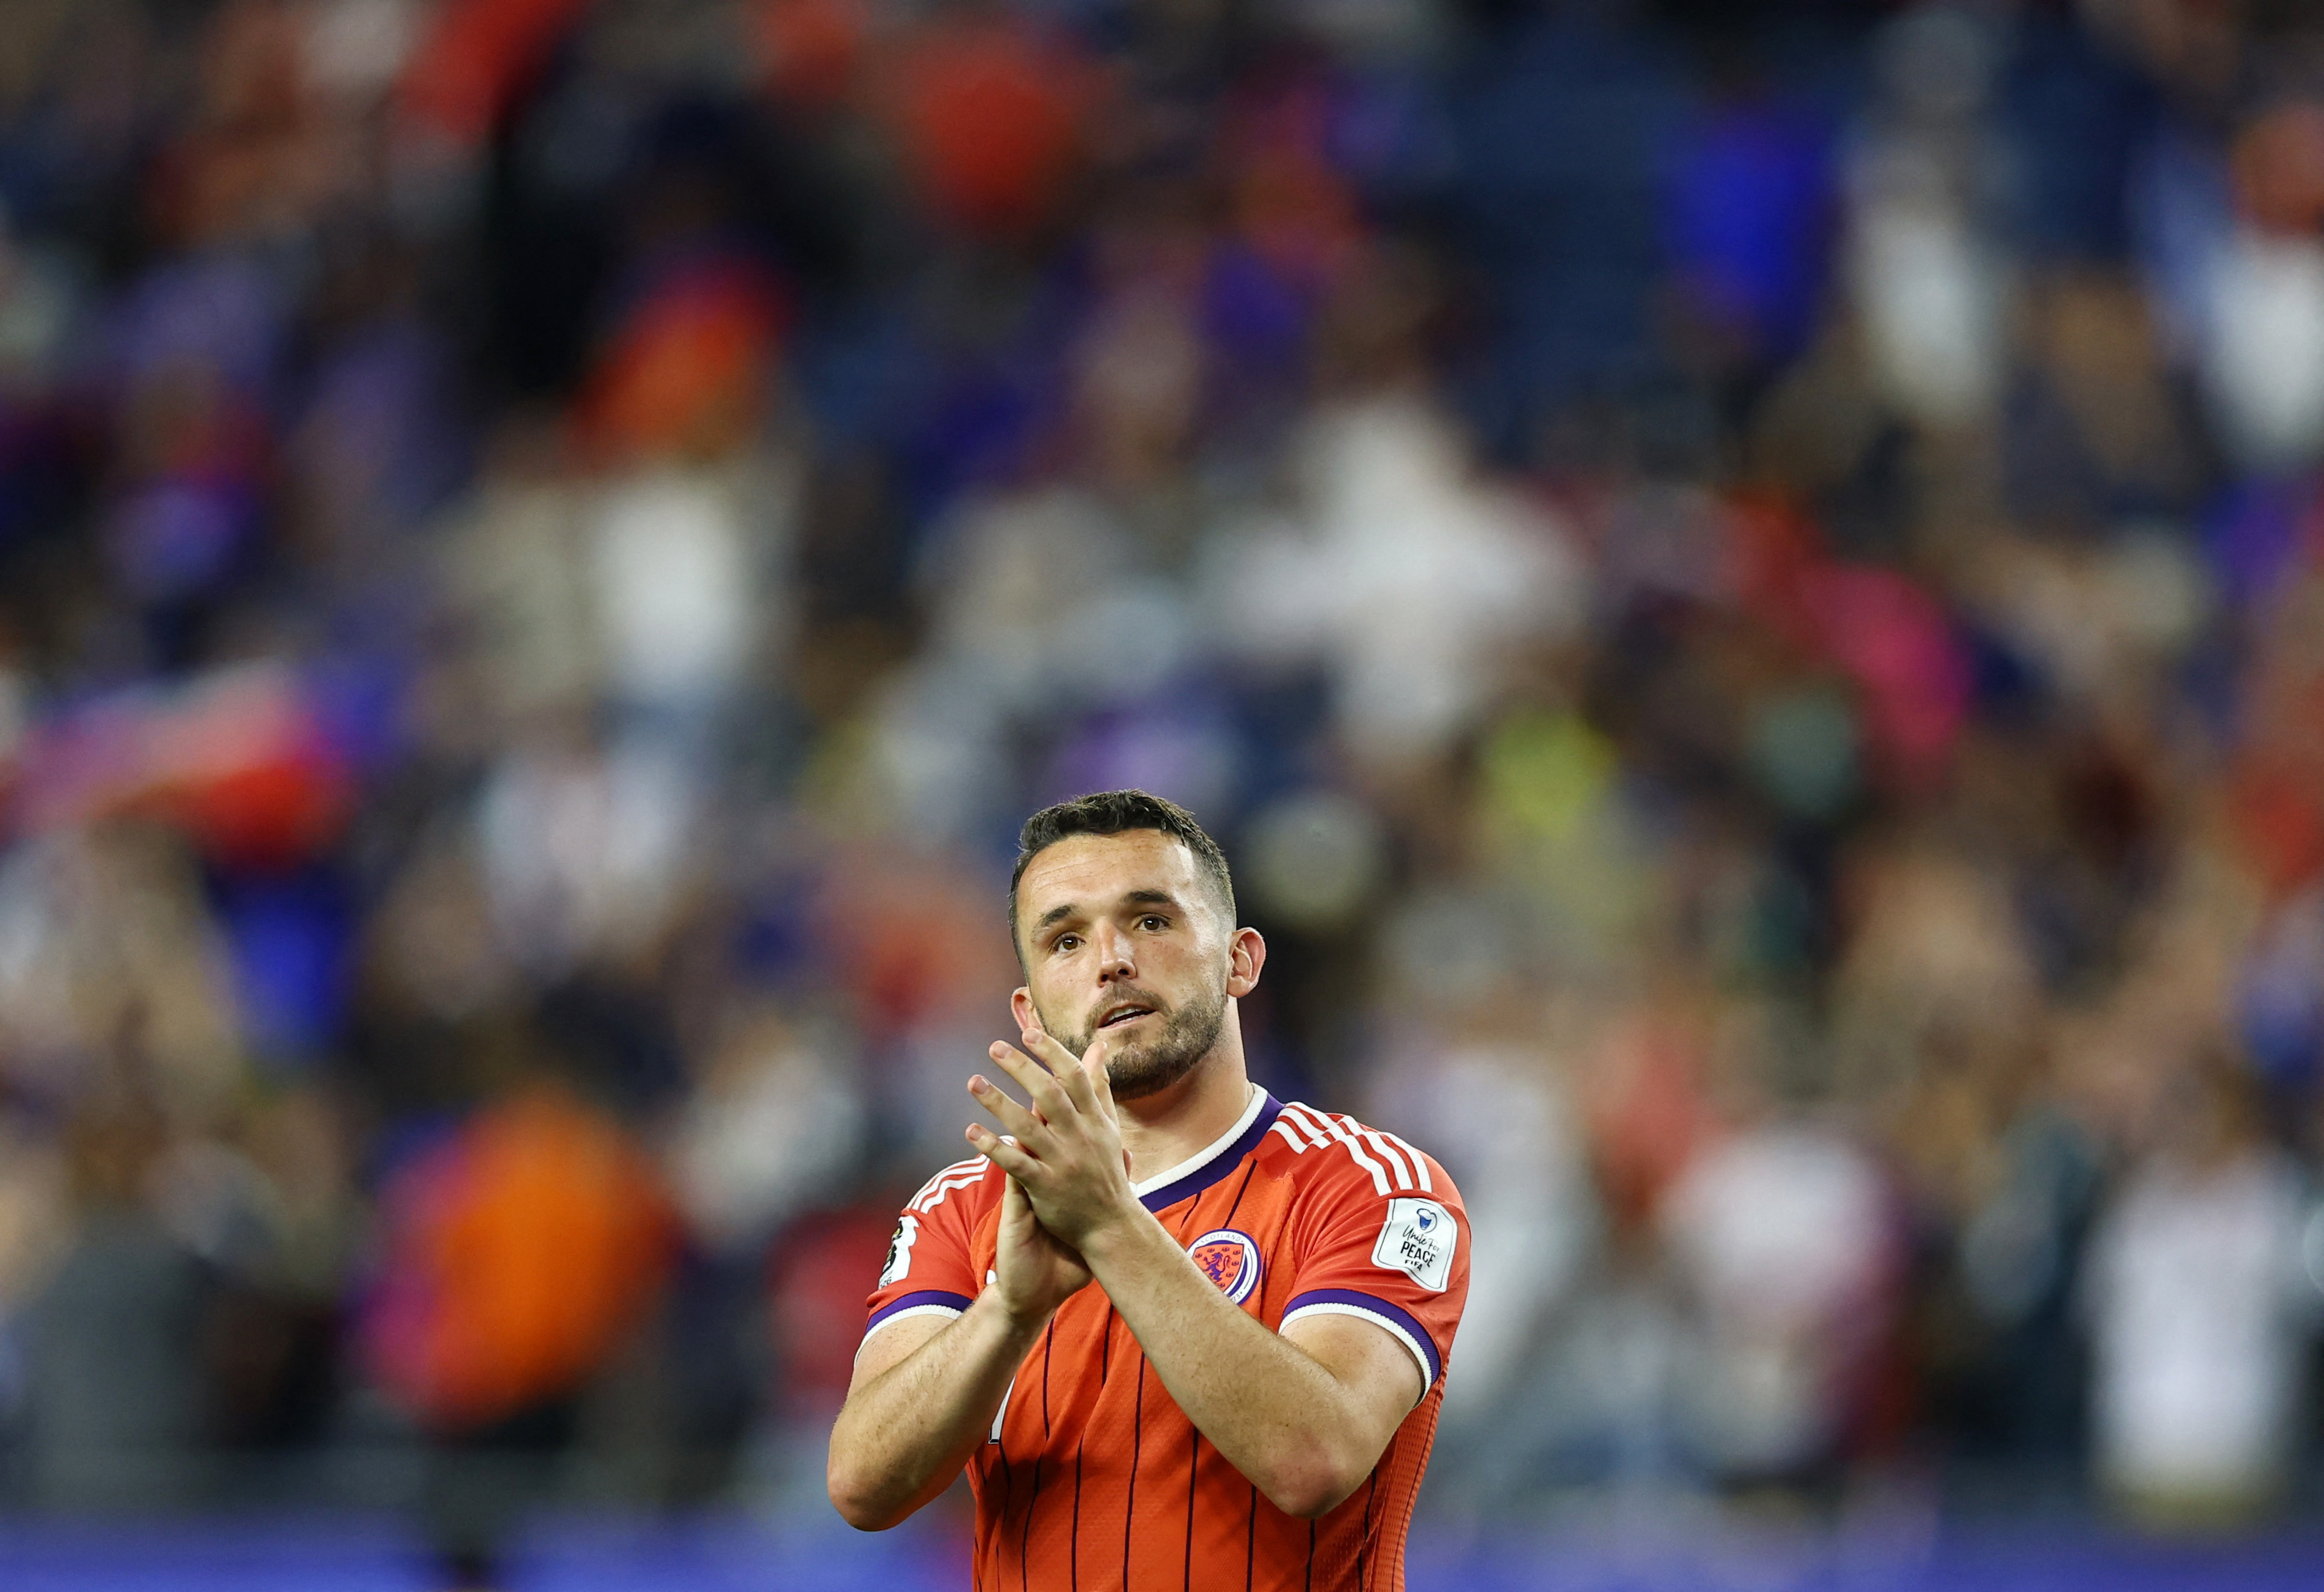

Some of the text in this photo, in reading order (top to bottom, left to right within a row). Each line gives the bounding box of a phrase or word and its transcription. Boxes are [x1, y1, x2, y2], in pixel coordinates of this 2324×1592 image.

[1201, 1233, 1241, 1245] SCOTLAND
[1403, 1225, 1440, 1252] Unite For
[1400, 1241, 1436, 1267] PEACE
[1405, 1259, 1423, 1272] FIFA
